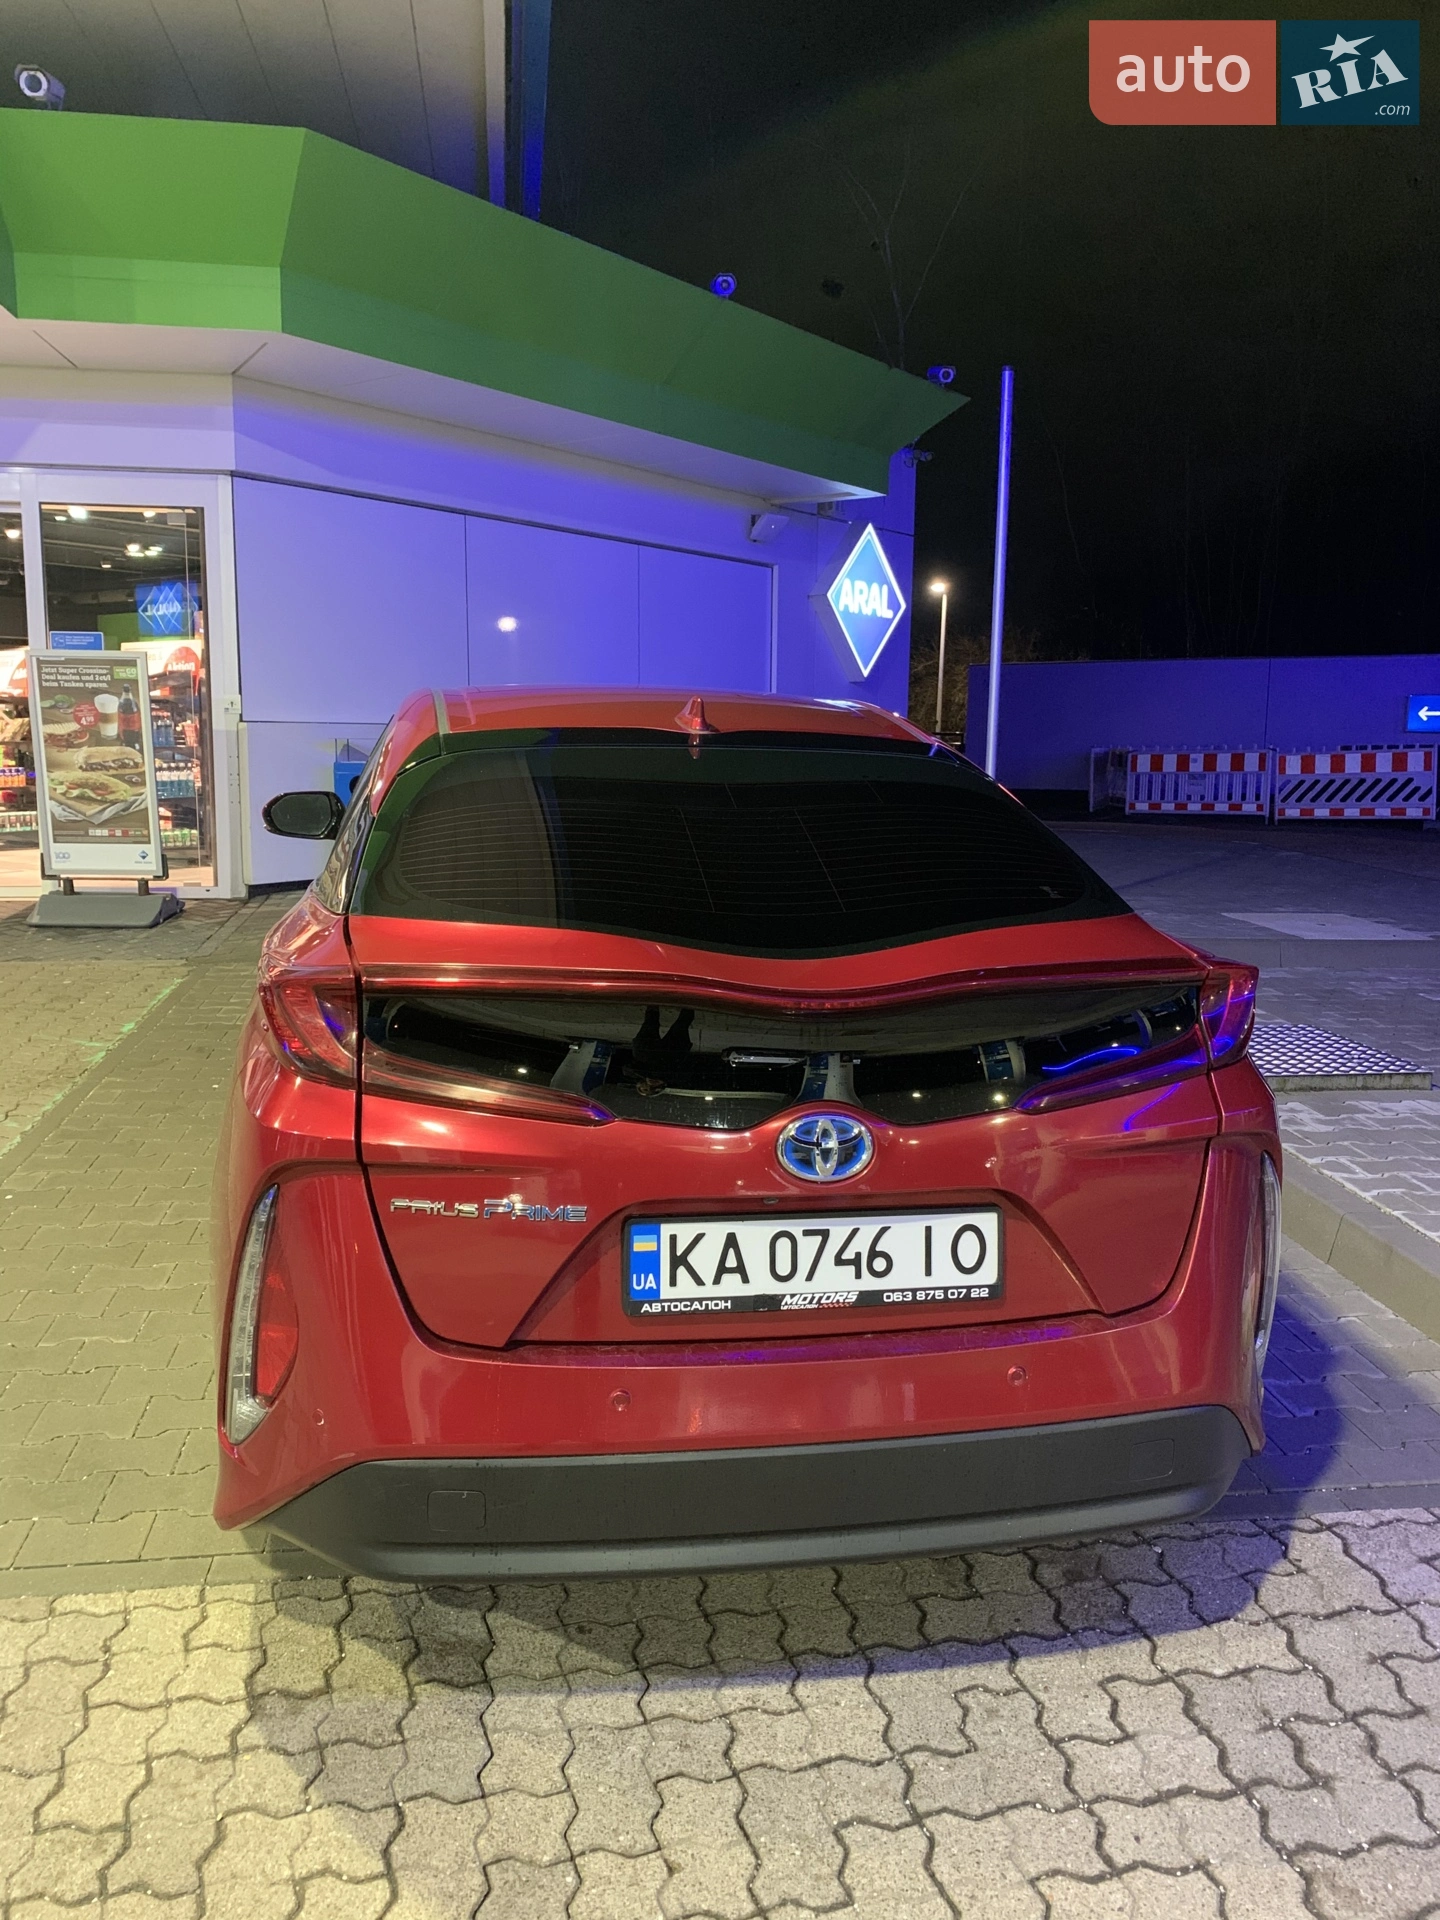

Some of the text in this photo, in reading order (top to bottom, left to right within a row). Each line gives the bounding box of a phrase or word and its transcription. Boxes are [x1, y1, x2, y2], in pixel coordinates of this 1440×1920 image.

[838, 577, 894, 619] ARAL
[390, 1198, 588, 1222] PRIUS PRIME
[668, 1223, 987, 1287] KA 0746 IO
[632, 1274, 658, 1290] UA
[780, 1291, 860, 1306] MOTORS
[883, 1287, 990, 1303] 063 875 07 22
[640, 1299, 732, 1313] АВТОСАЛОН
